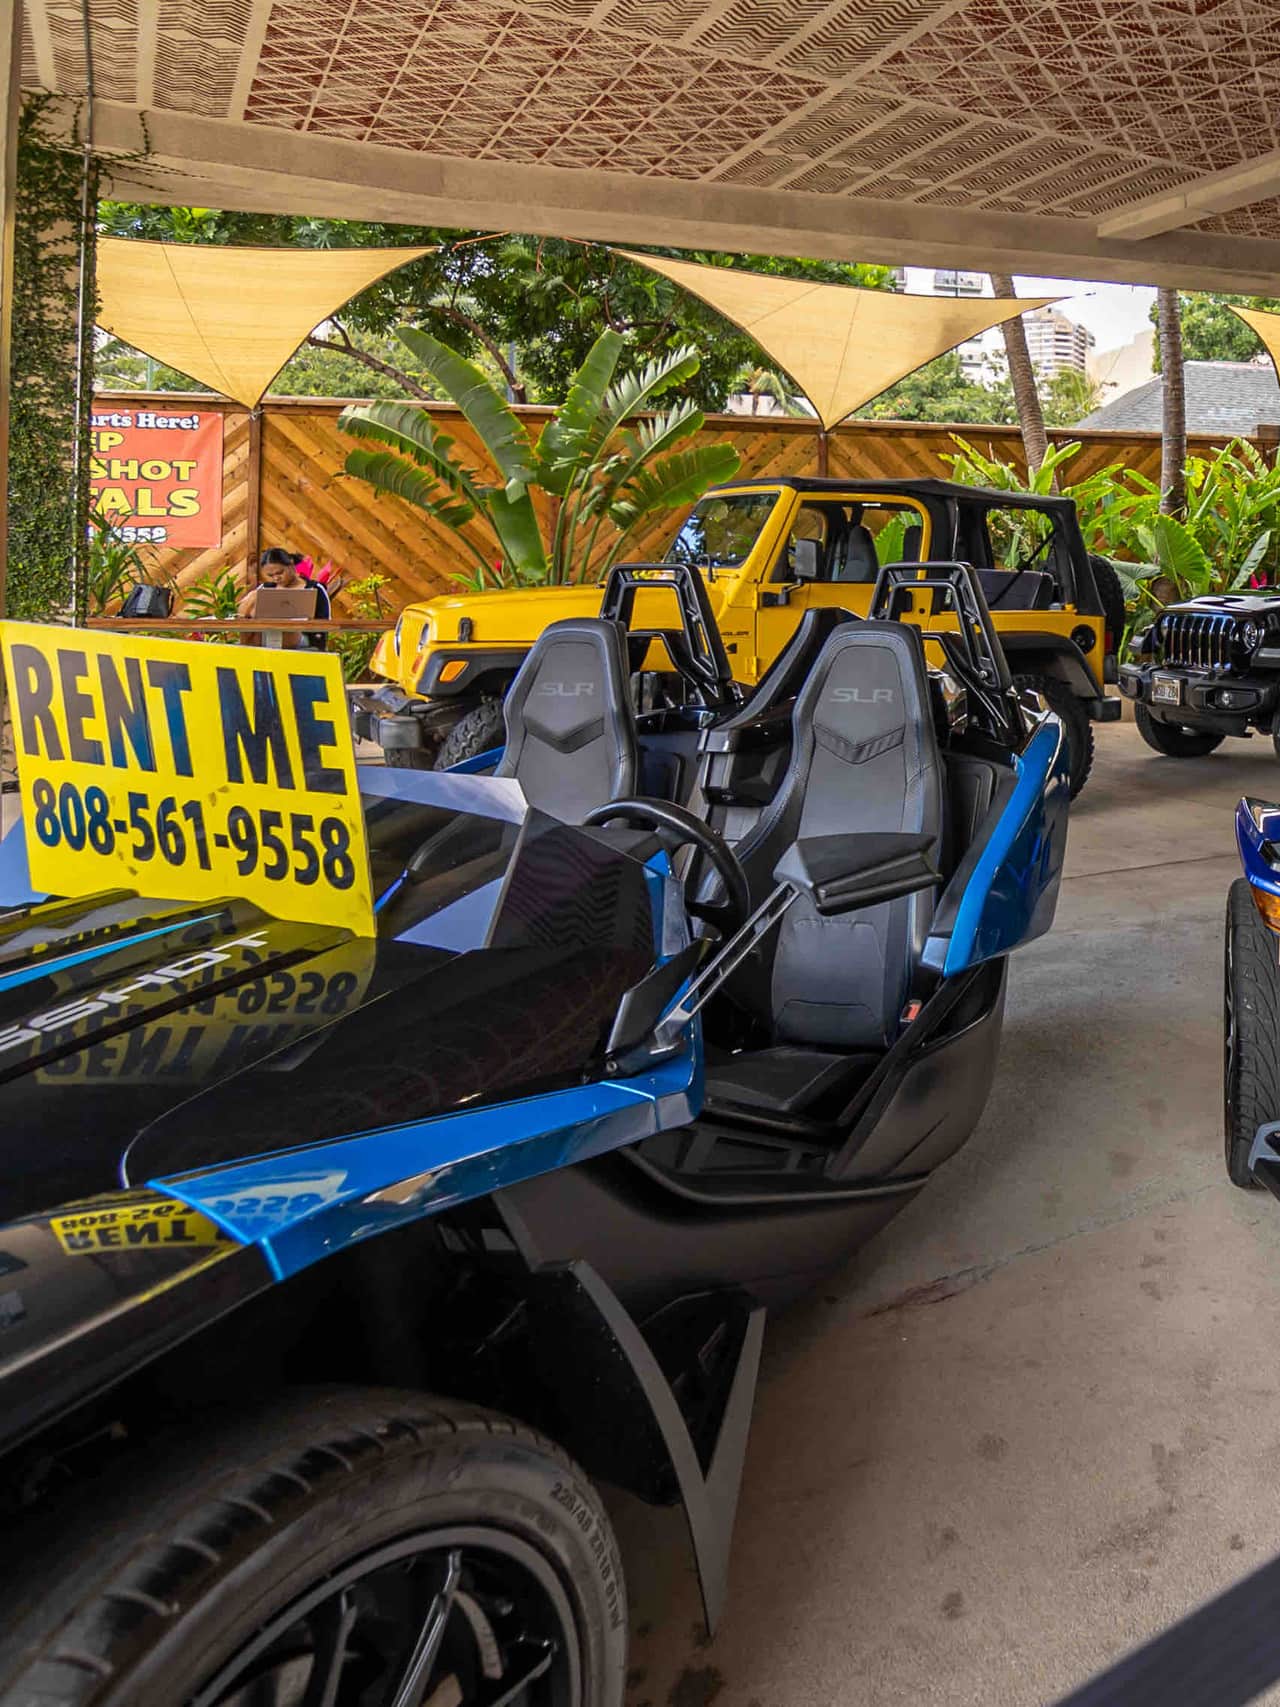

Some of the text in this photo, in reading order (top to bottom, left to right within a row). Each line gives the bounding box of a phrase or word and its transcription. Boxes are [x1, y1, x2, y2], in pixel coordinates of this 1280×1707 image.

[136, 412, 200, 429] Here!
[89, 487, 201, 516] ALS
[538, 681, 594, 697] SLR
[830, 687, 893, 703] SLR
[10, 643, 348, 796] RENT ME
[32, 778, 356, 891] 808-561-9558
